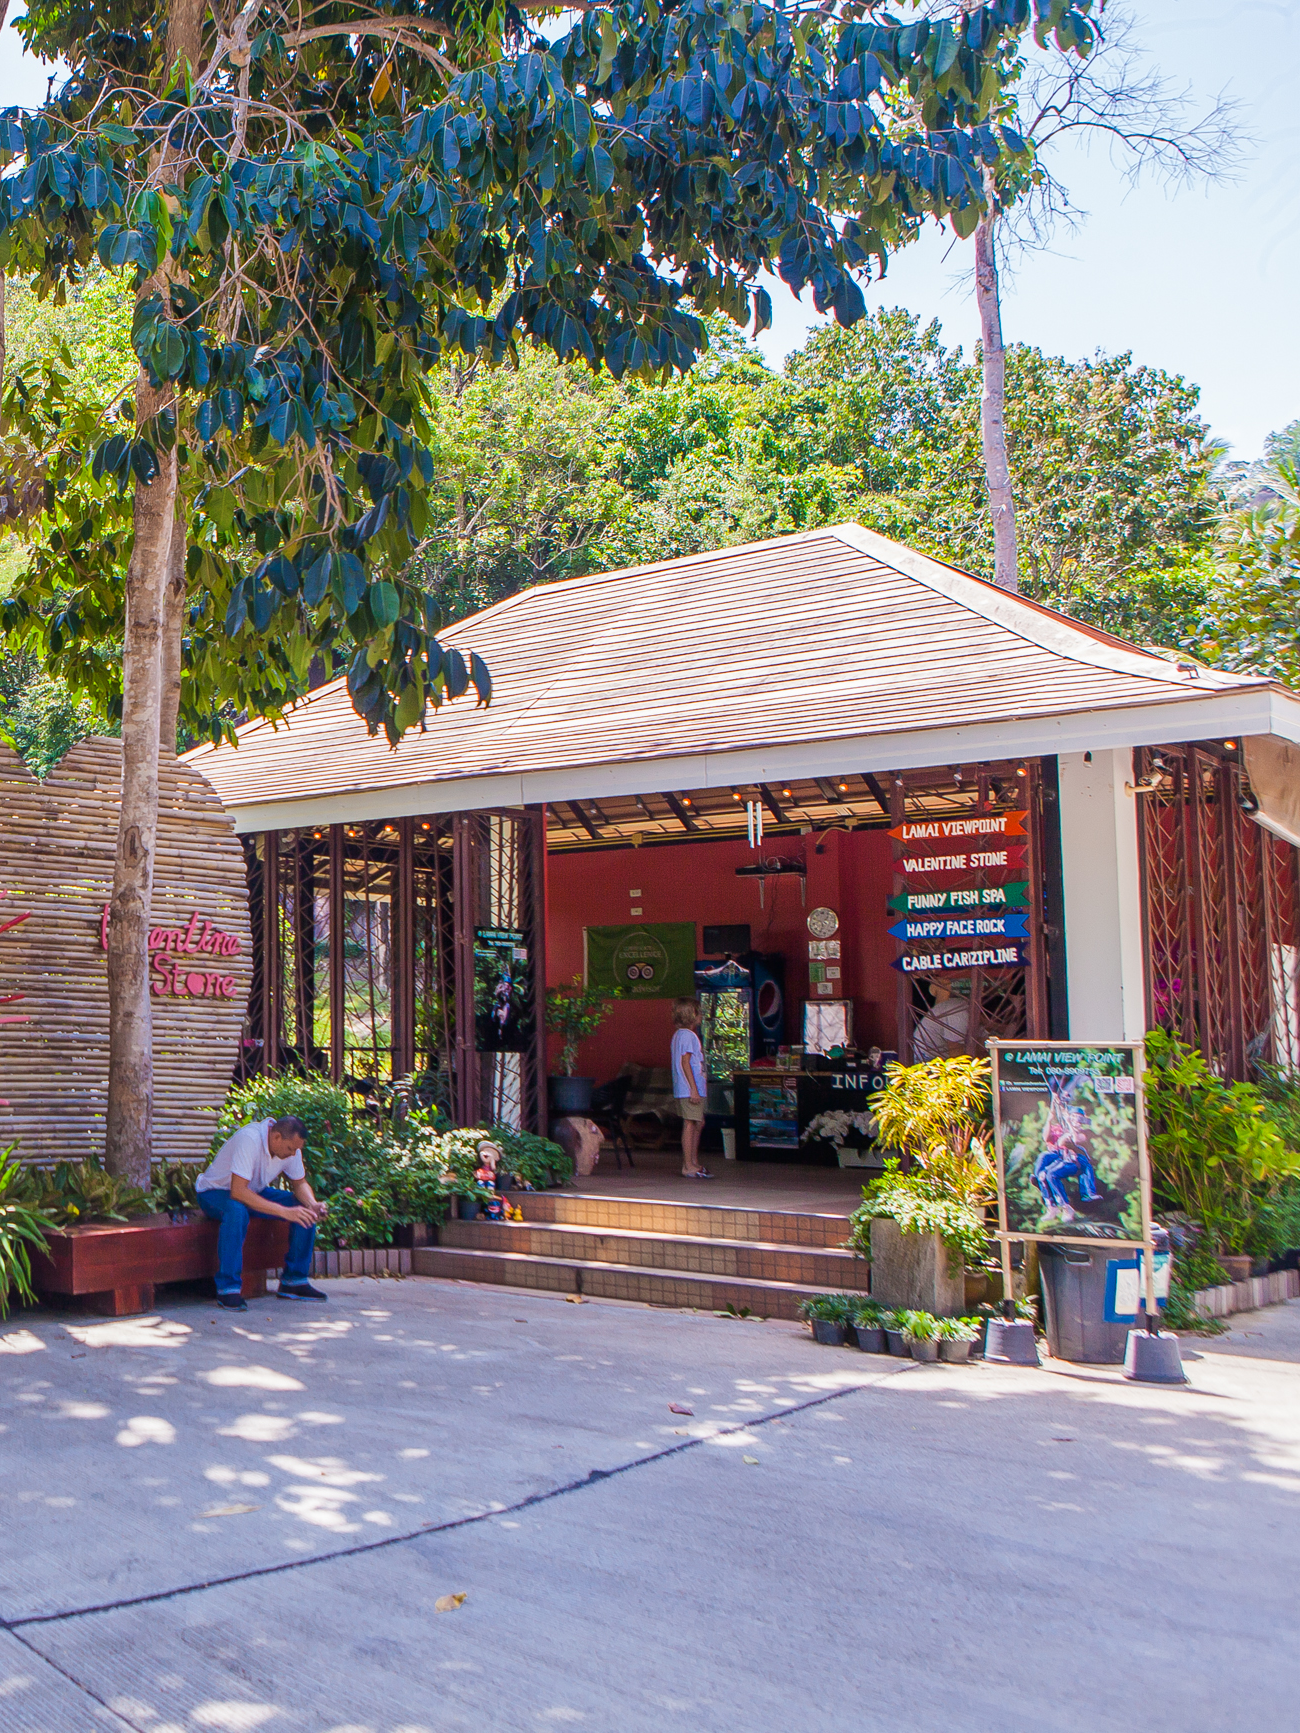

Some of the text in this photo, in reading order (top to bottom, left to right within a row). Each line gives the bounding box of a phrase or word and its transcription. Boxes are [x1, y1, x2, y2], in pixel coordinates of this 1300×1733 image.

[902, 817, 1007, 839] LAMAI VIEWPOINT
[903, 851, 1008, 872] VALENTINE STONE
[907, 888, 1006, 909] FUNNY FISH SPA
[101, 903, 242, 956] entine
[906, 919, 1006, 937] HAPPY FACE ROCK
[902, 954, 942, 971] CABLE
[1016, 1052, 1052, 1064] LAMAI
[1053, 1052, 1085, 1064] VIEW
[1086, 1052, 1126, 1065] POINT
